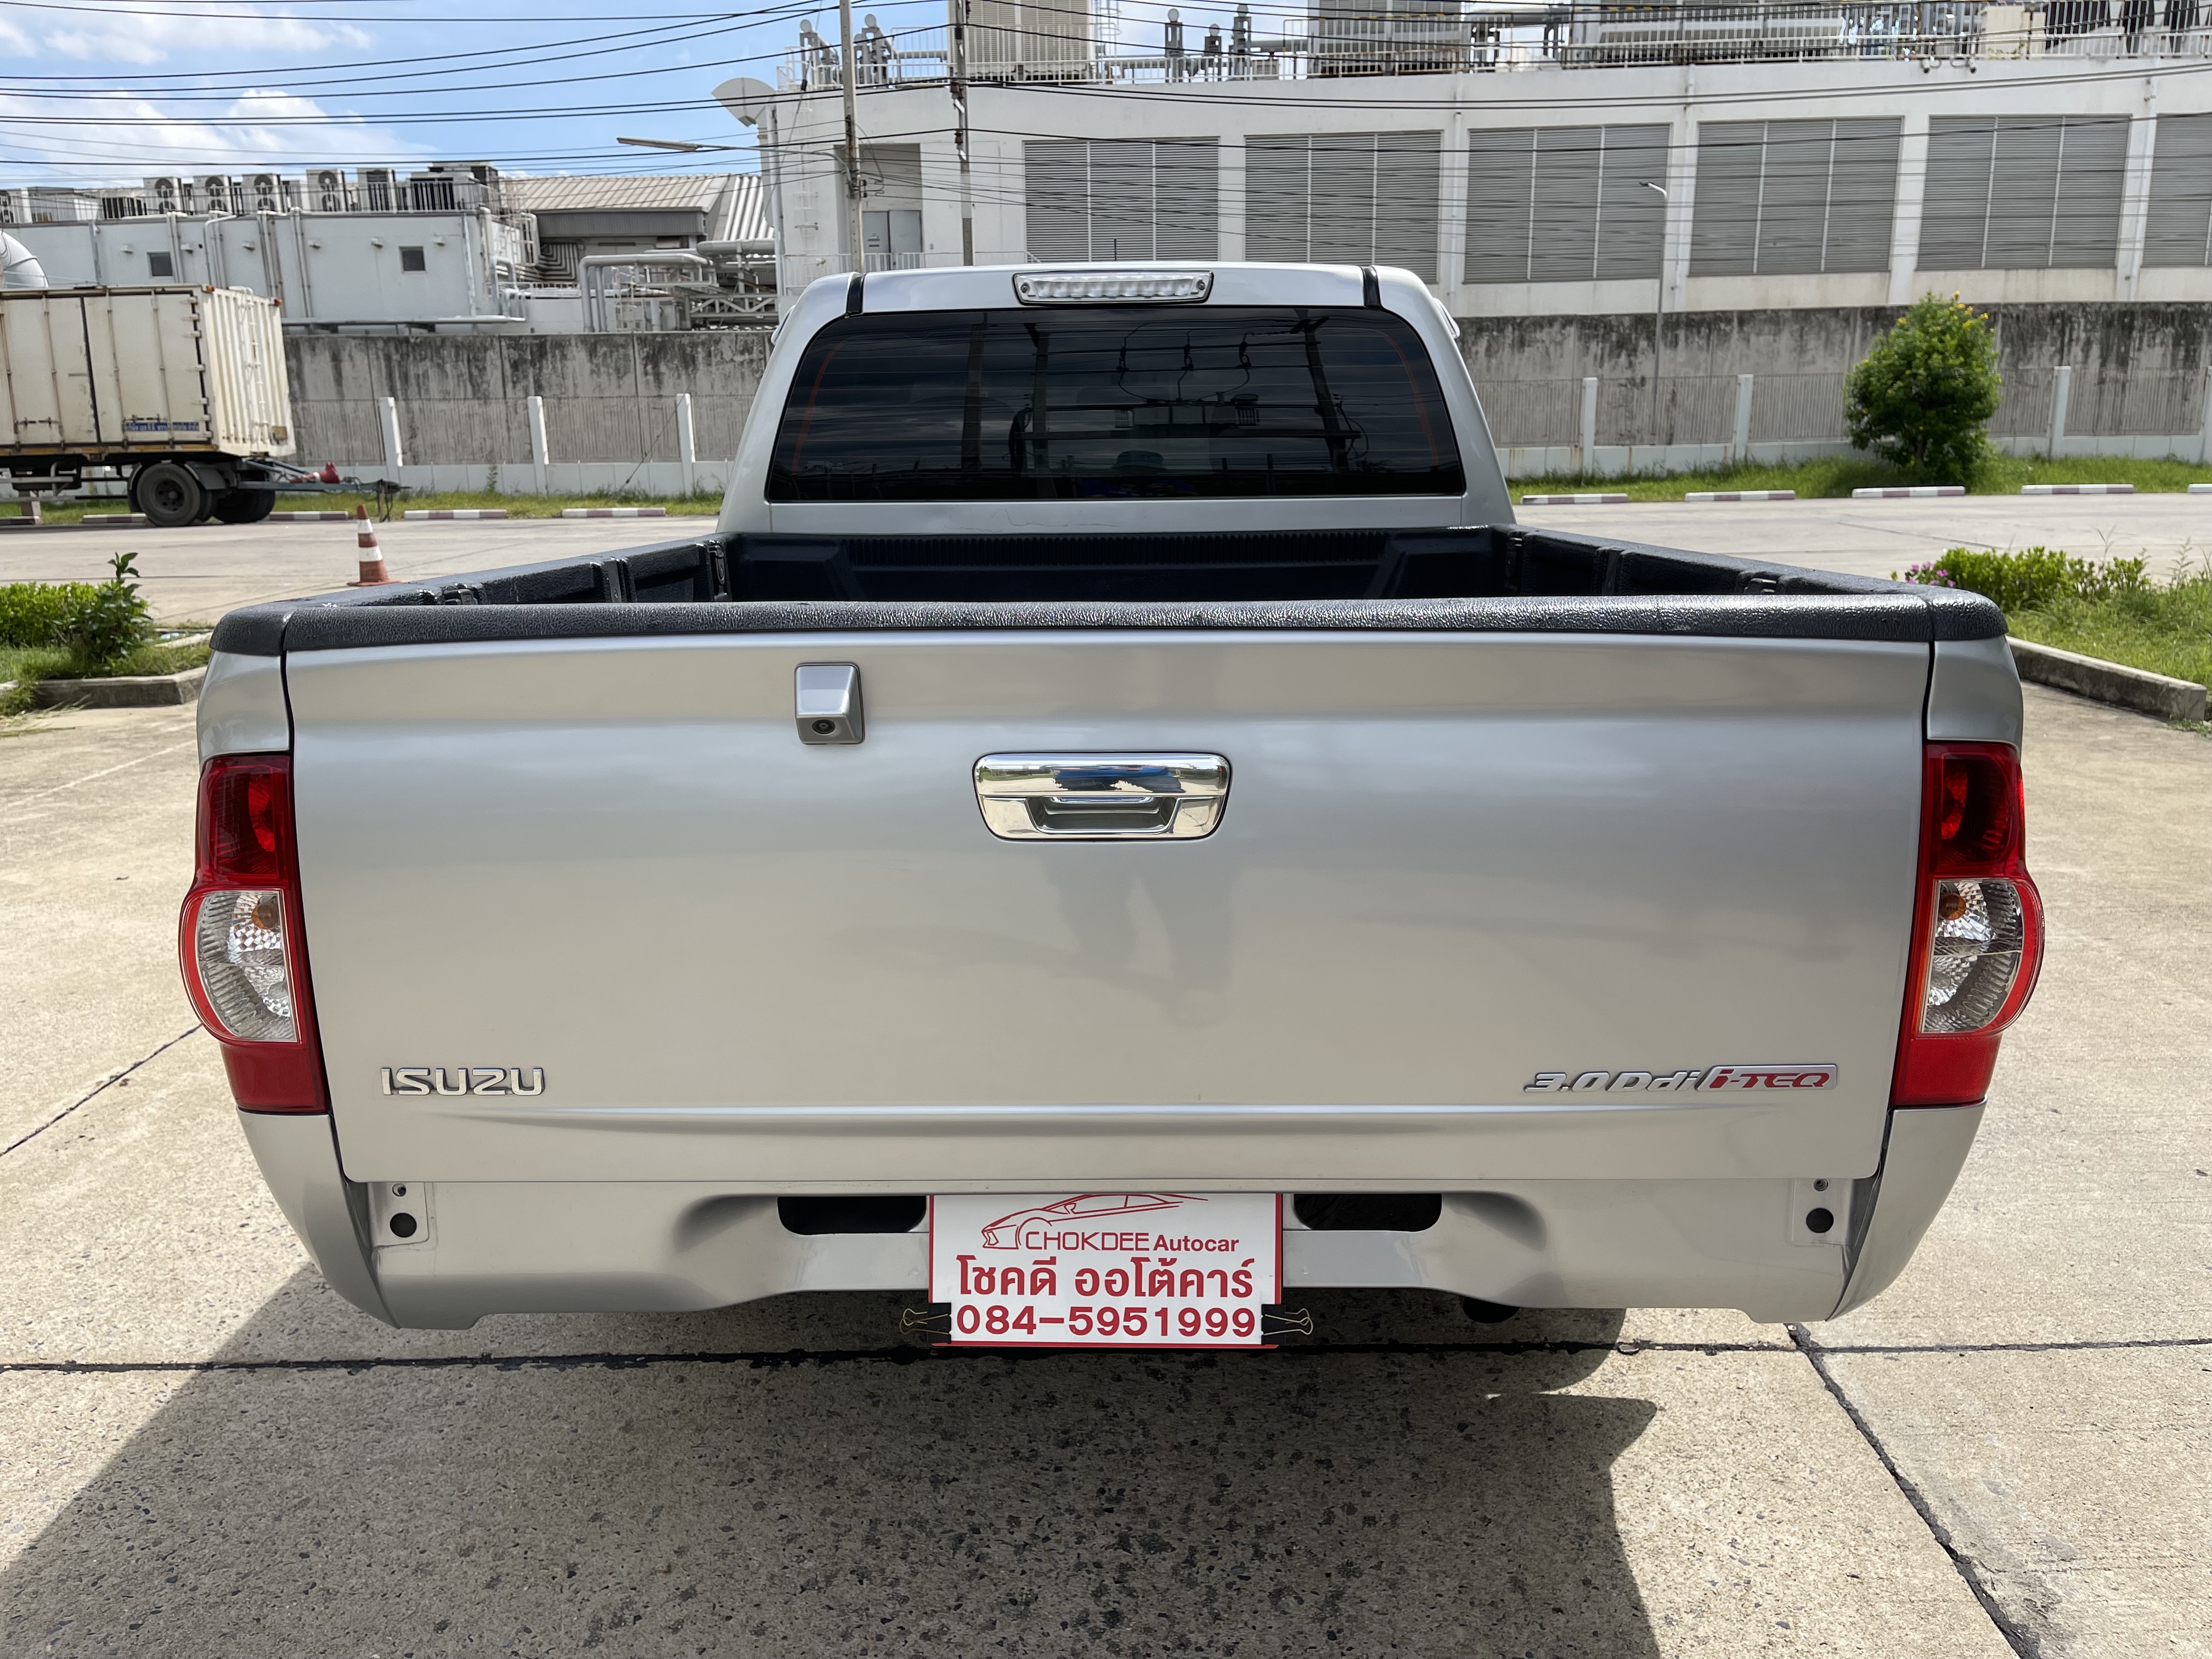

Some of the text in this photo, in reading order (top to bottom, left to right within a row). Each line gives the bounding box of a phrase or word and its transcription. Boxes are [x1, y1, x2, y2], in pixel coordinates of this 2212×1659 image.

[381, 1067, 544, 1096] ISUZU
[1025, 1231, 1240, 1252] CHOKDEE Autocar
[956, 1254, 1255, 1299] โชคดี ออโต้คาร์
[957, 1304, 1256, 1338] 084-5951999
